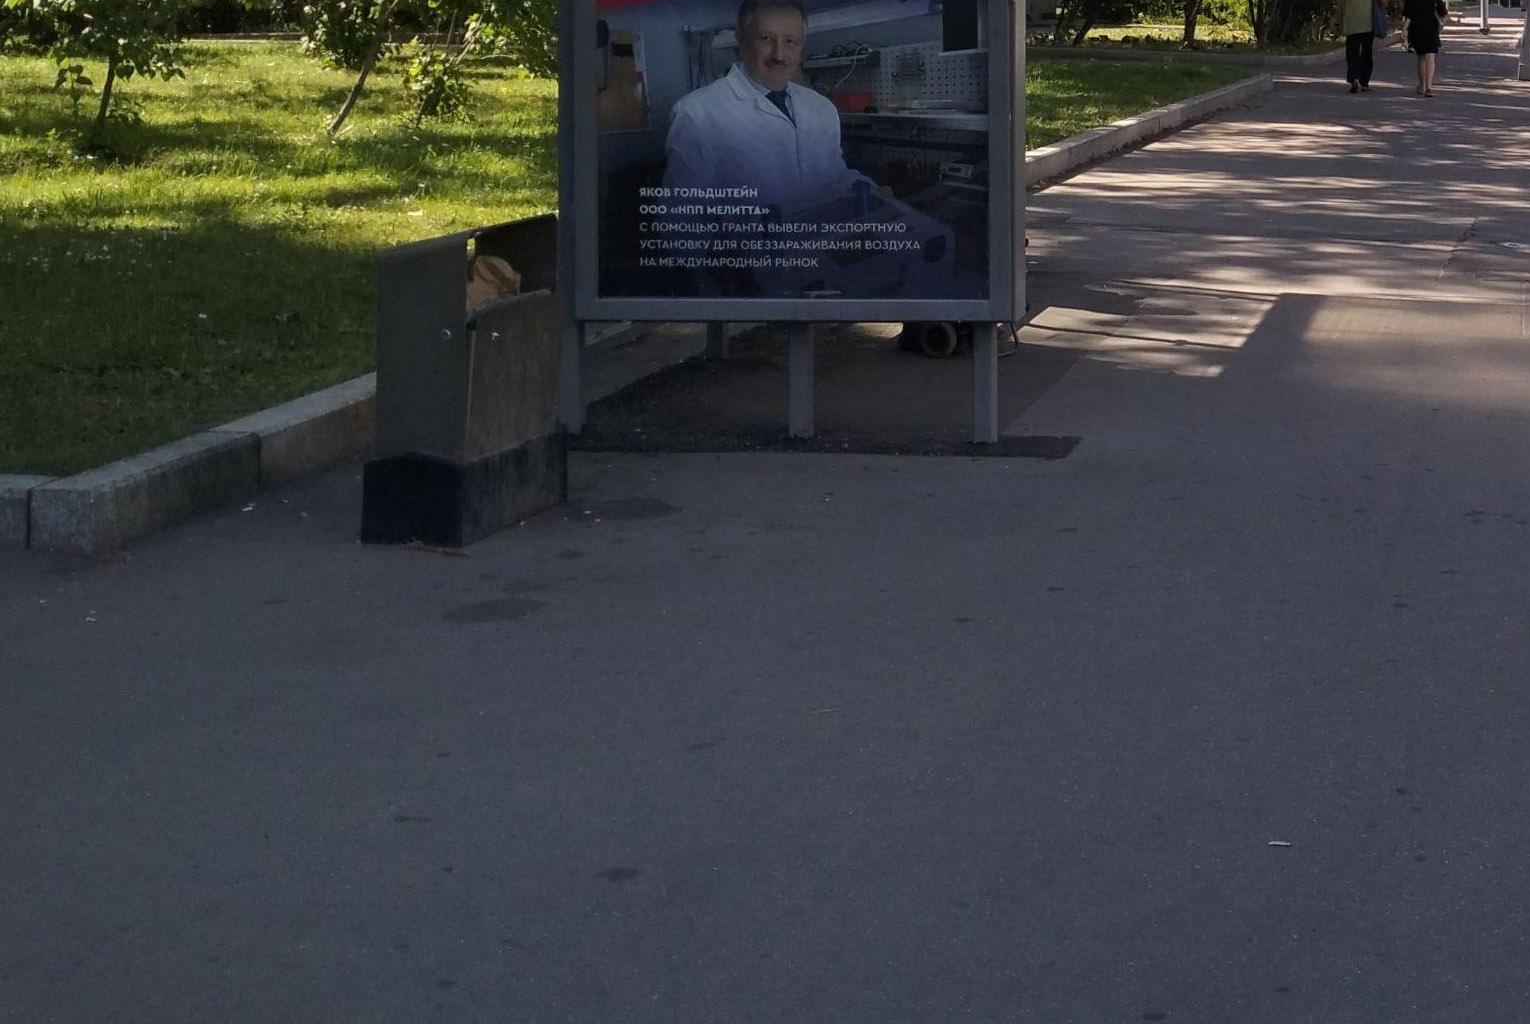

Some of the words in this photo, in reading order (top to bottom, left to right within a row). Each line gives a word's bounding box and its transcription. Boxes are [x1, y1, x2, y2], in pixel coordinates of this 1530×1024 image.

[639, 187, 671, 198] ЯКОВ
[674, 185, 758, 199] ГОЛЬДШТЕЙН
[639, 205, 667, 215] ООО
[671, 205, 704, 215] «НПП
[707, 205, 770, 215] МЕЛИТТА»
[639, 223, 648, 233] С
[651, 222, 719, 234] ПОМОЩЬЮ
[722, 223, 765, 233] ГРАНТА
[768, 223, 817, 233] ВЫВЕЛИ
[821, 222, 907, 233] ЭКСПОРТНУЮ
[639, 240, 709, 251] УСТАНОВКУ
[713, 240, 738, 251] ДЛЯ
[740, 240, 862, 251] ОБЕЗЗАРАЖИВАНИЯ
[865, 240, 921, 252] ВОЗДУХА
[639, 257, 656, 268] НА
[659, 255, 772, 269] МЕЖДУНАРОДНЫЙ
[775, 258, 819, 269] РЫНОК
